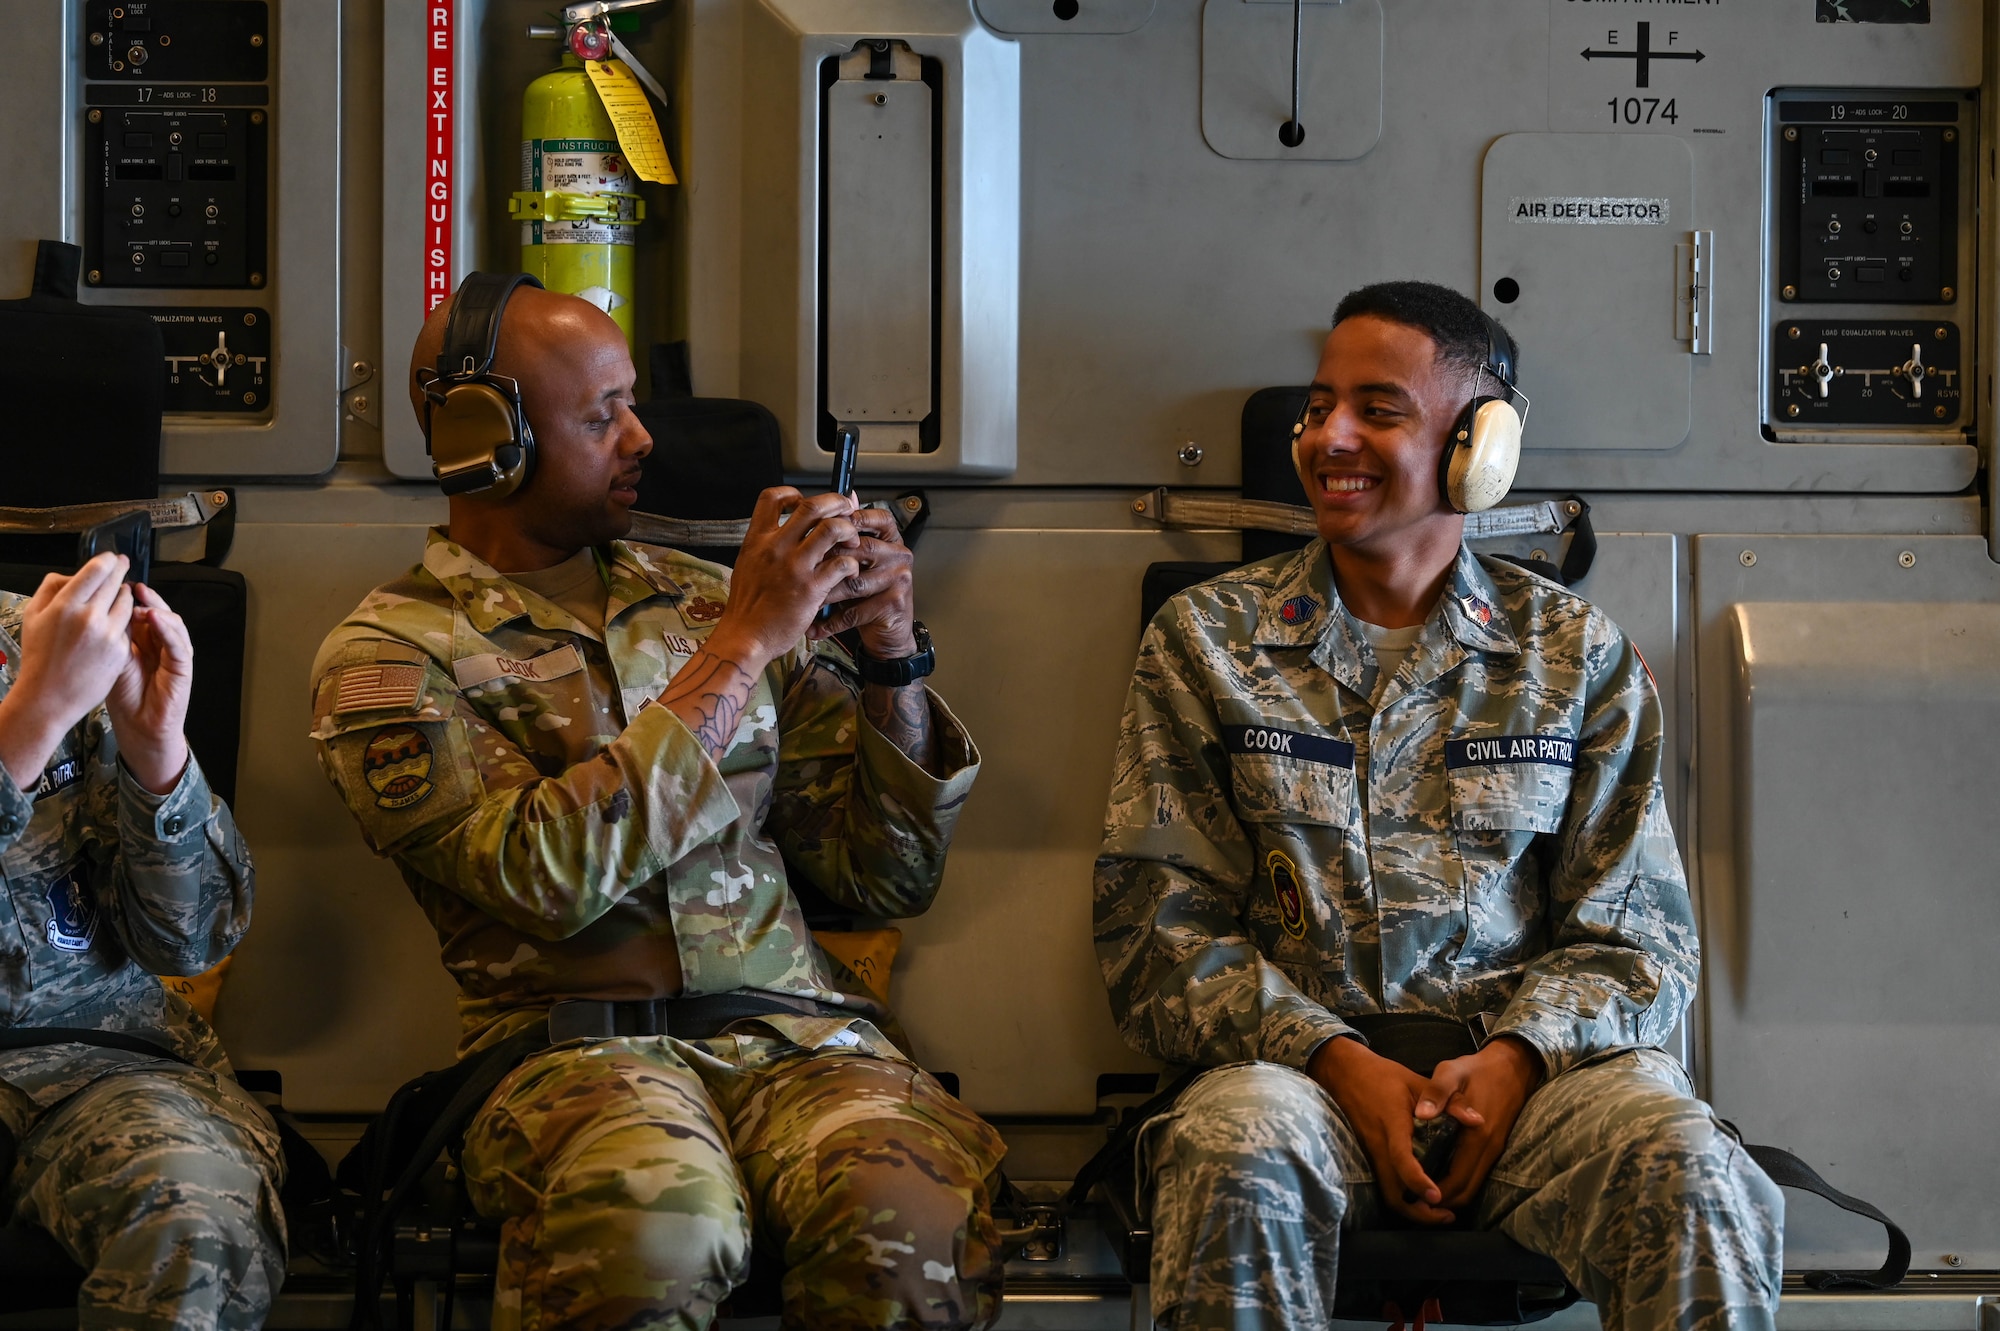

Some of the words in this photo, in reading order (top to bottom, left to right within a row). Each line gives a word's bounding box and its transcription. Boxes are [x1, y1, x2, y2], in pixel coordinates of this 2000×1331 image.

[432, 0, 448, 50] RE
[1608, 30, 1618, 45] E
[1669, 31, 1678, 45] F
[138, 88, 153, 102] 17
[201, 88, 216, 102] 18
[1608, 97, 1678, 124] 1074
[1830, 105, 1845, 120] 19
[1892, 105, 1908, 119] 20
[558, 142, 620, 150] INSTRUCTIO
[430, 67, 448, 310] EXTINGUISHE
[1516, 204, 1546, 217] AIR
[1553, 204, 1661, 218] DEFLECTOR
[170, 376, 180, 384] 18
[254, 376, 263, 385] 19
[1782, 389, 1791, 397] 19
[1862, 389, 1872, 397] 20
[1937, 390, 1960, 398] RSVR
[496, 657, 541, 679] COOK
[1244, 728, 1294, 753] COOK
[1466, 740, 1506, 761] CIVIL
[1510, 739, 1537, 759] AIR
[1539, 739, 1573, 762] PATROL
[52, 759, 83, 788] PATROL
